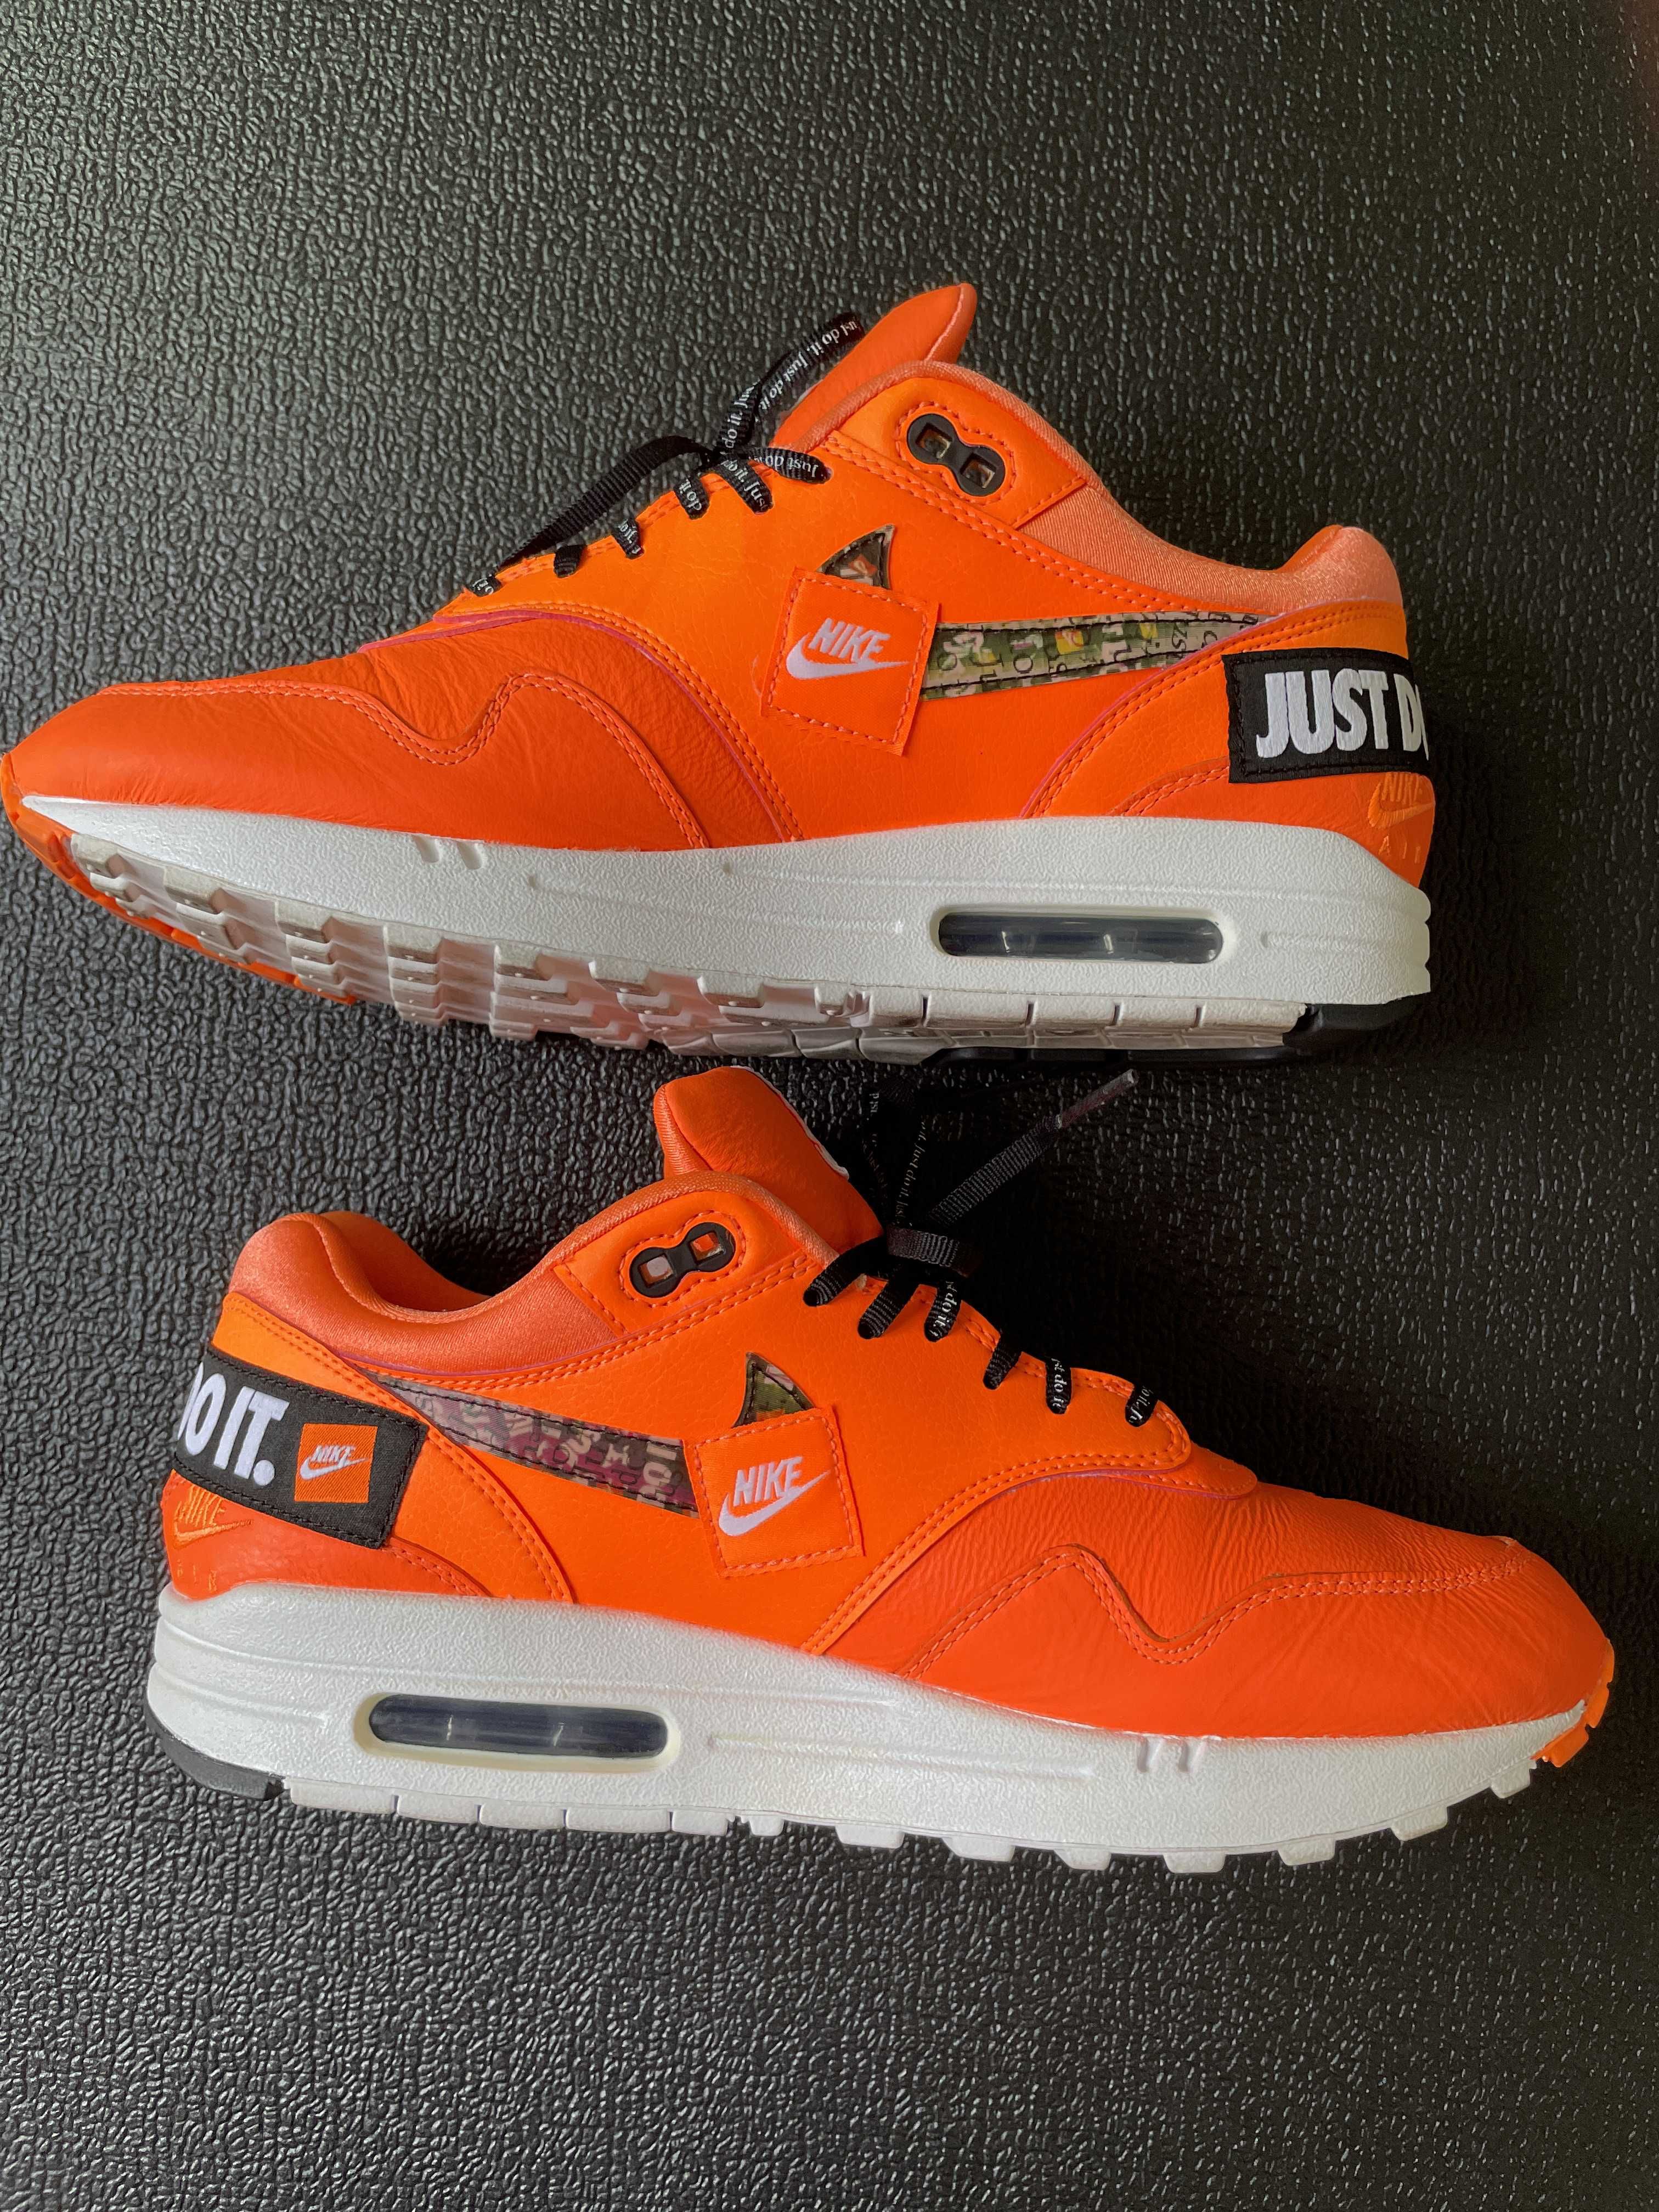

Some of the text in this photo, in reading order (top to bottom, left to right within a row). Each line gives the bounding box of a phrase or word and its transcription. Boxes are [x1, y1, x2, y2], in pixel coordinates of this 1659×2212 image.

[821, 329, 840, 345] do
[782, 351, 809, 382] Just
[769, 379, 784, 399] do
[721, 426, 738, 448] do
[765, 455, 785, 471] do
[788, 456, 819, 478] Just
[686, 490, 702, 511] do
[743, 480, 766, 511] Jus
[807, 617, 891, 664] NIKE
[1256, 667, 1430, 761] JUST D
[941, 1293, 957, 1312] do
[1054, 1374, 1068, 1393] do
[213, 1386, 290, 1486] IT.
[311, 1444, 357, 1468] NIKE
[732, 1455, 804, 1507] NIKE
